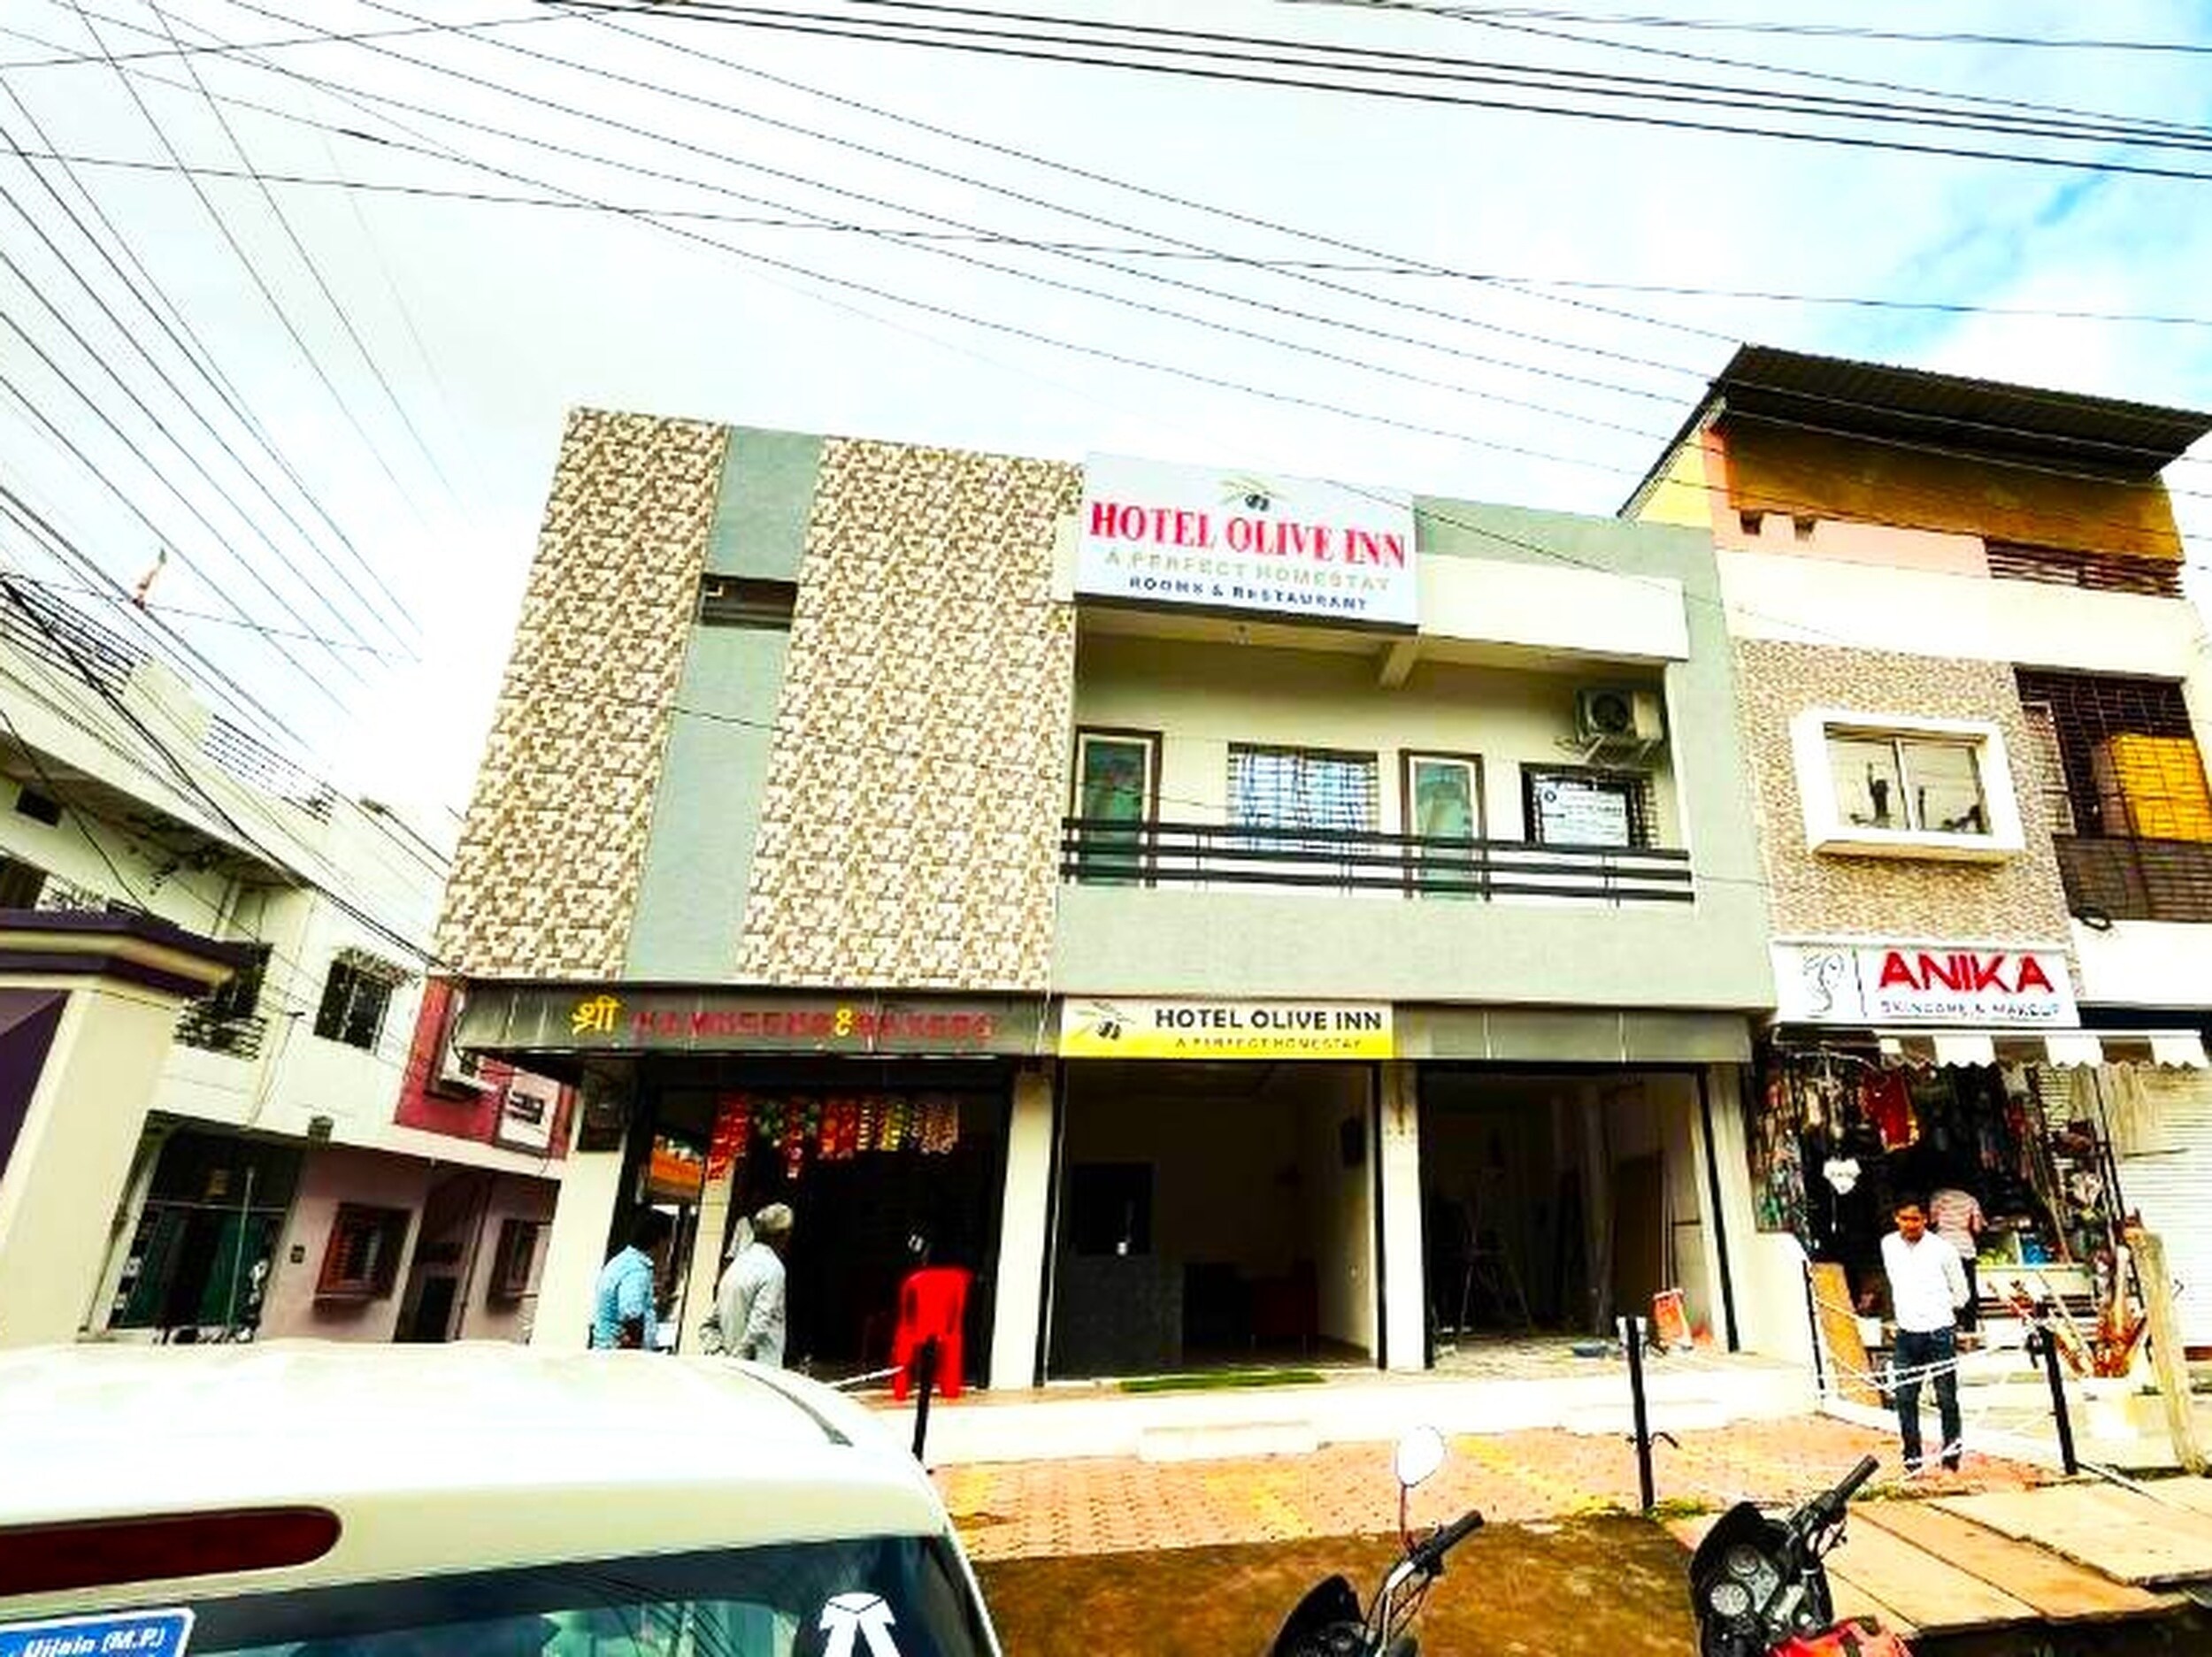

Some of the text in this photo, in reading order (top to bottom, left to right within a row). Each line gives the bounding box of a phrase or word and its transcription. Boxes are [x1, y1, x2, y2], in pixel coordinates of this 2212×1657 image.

[1089, 501, 1406, 569] HOTEL OLIVE INN
[1104, 549, 1391, 592] A PERFECT HOMESTAY
[1129, 577, 1369, 611] ROOMS & RESTAURANT
[1878, 951, 2056, 993] ANIKA
[572, 994, 620, 1035] श्री
[1155, 1009, 1382, 1031] HOTEL OLIVE INN
[1175, 1038, 1363, 1050] A PERFECT HOMESTAY
[101, 1627, 166, 1653] (M.P.)
